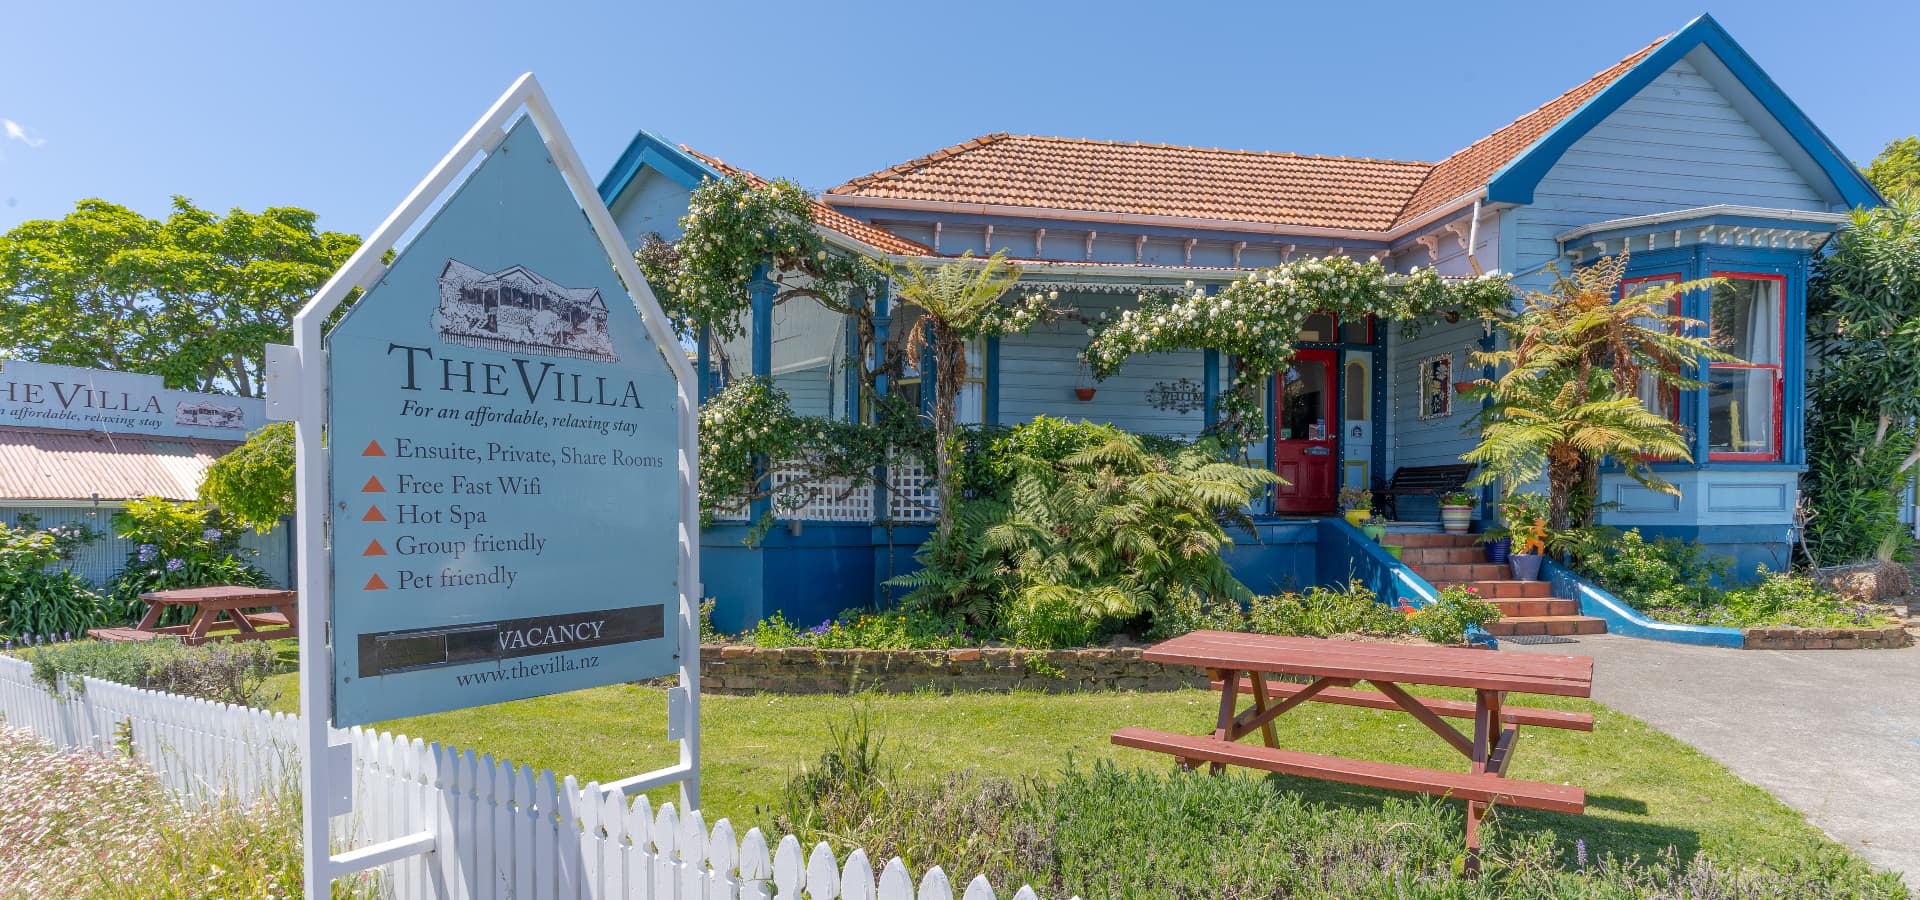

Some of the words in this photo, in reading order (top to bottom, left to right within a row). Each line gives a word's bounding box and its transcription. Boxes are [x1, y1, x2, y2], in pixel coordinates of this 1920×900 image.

[10, 407, 80, 422] affordable,
[84, 414, 134, 427] relaxing
[139, 418, 163, 429] stay
[400, 400, 434, 417] For
[438, 409, 459, 419] an
[464, 407, 548, 429] affordable,
[552, 416, 609, 435] relaxing
[612, 421, 638, 436] stay
[395, 438, 482, 464] Ensuite,
[487, 442, 556, 467] Private,
[561, 447, 607, 465] Share
[612, 449, 664, 468] Rooms
[396, 474, 444, 494] Free
[450, 474, 493, 495] Fast
[497, 476, 542, 495] Wifi
[396, 504, 442, 524] Hot
[449, 505, 488, 529] Spa
[395, 536, 466, 560] Group
[472, 533, 547, 557] friendly
[397, 570, 433, 590] Pet
[440, 566, 518, 589] friendly
[499, 620, 605, 651] VACANCY
[456, 654, 600, 688] www.thevilla.nz
